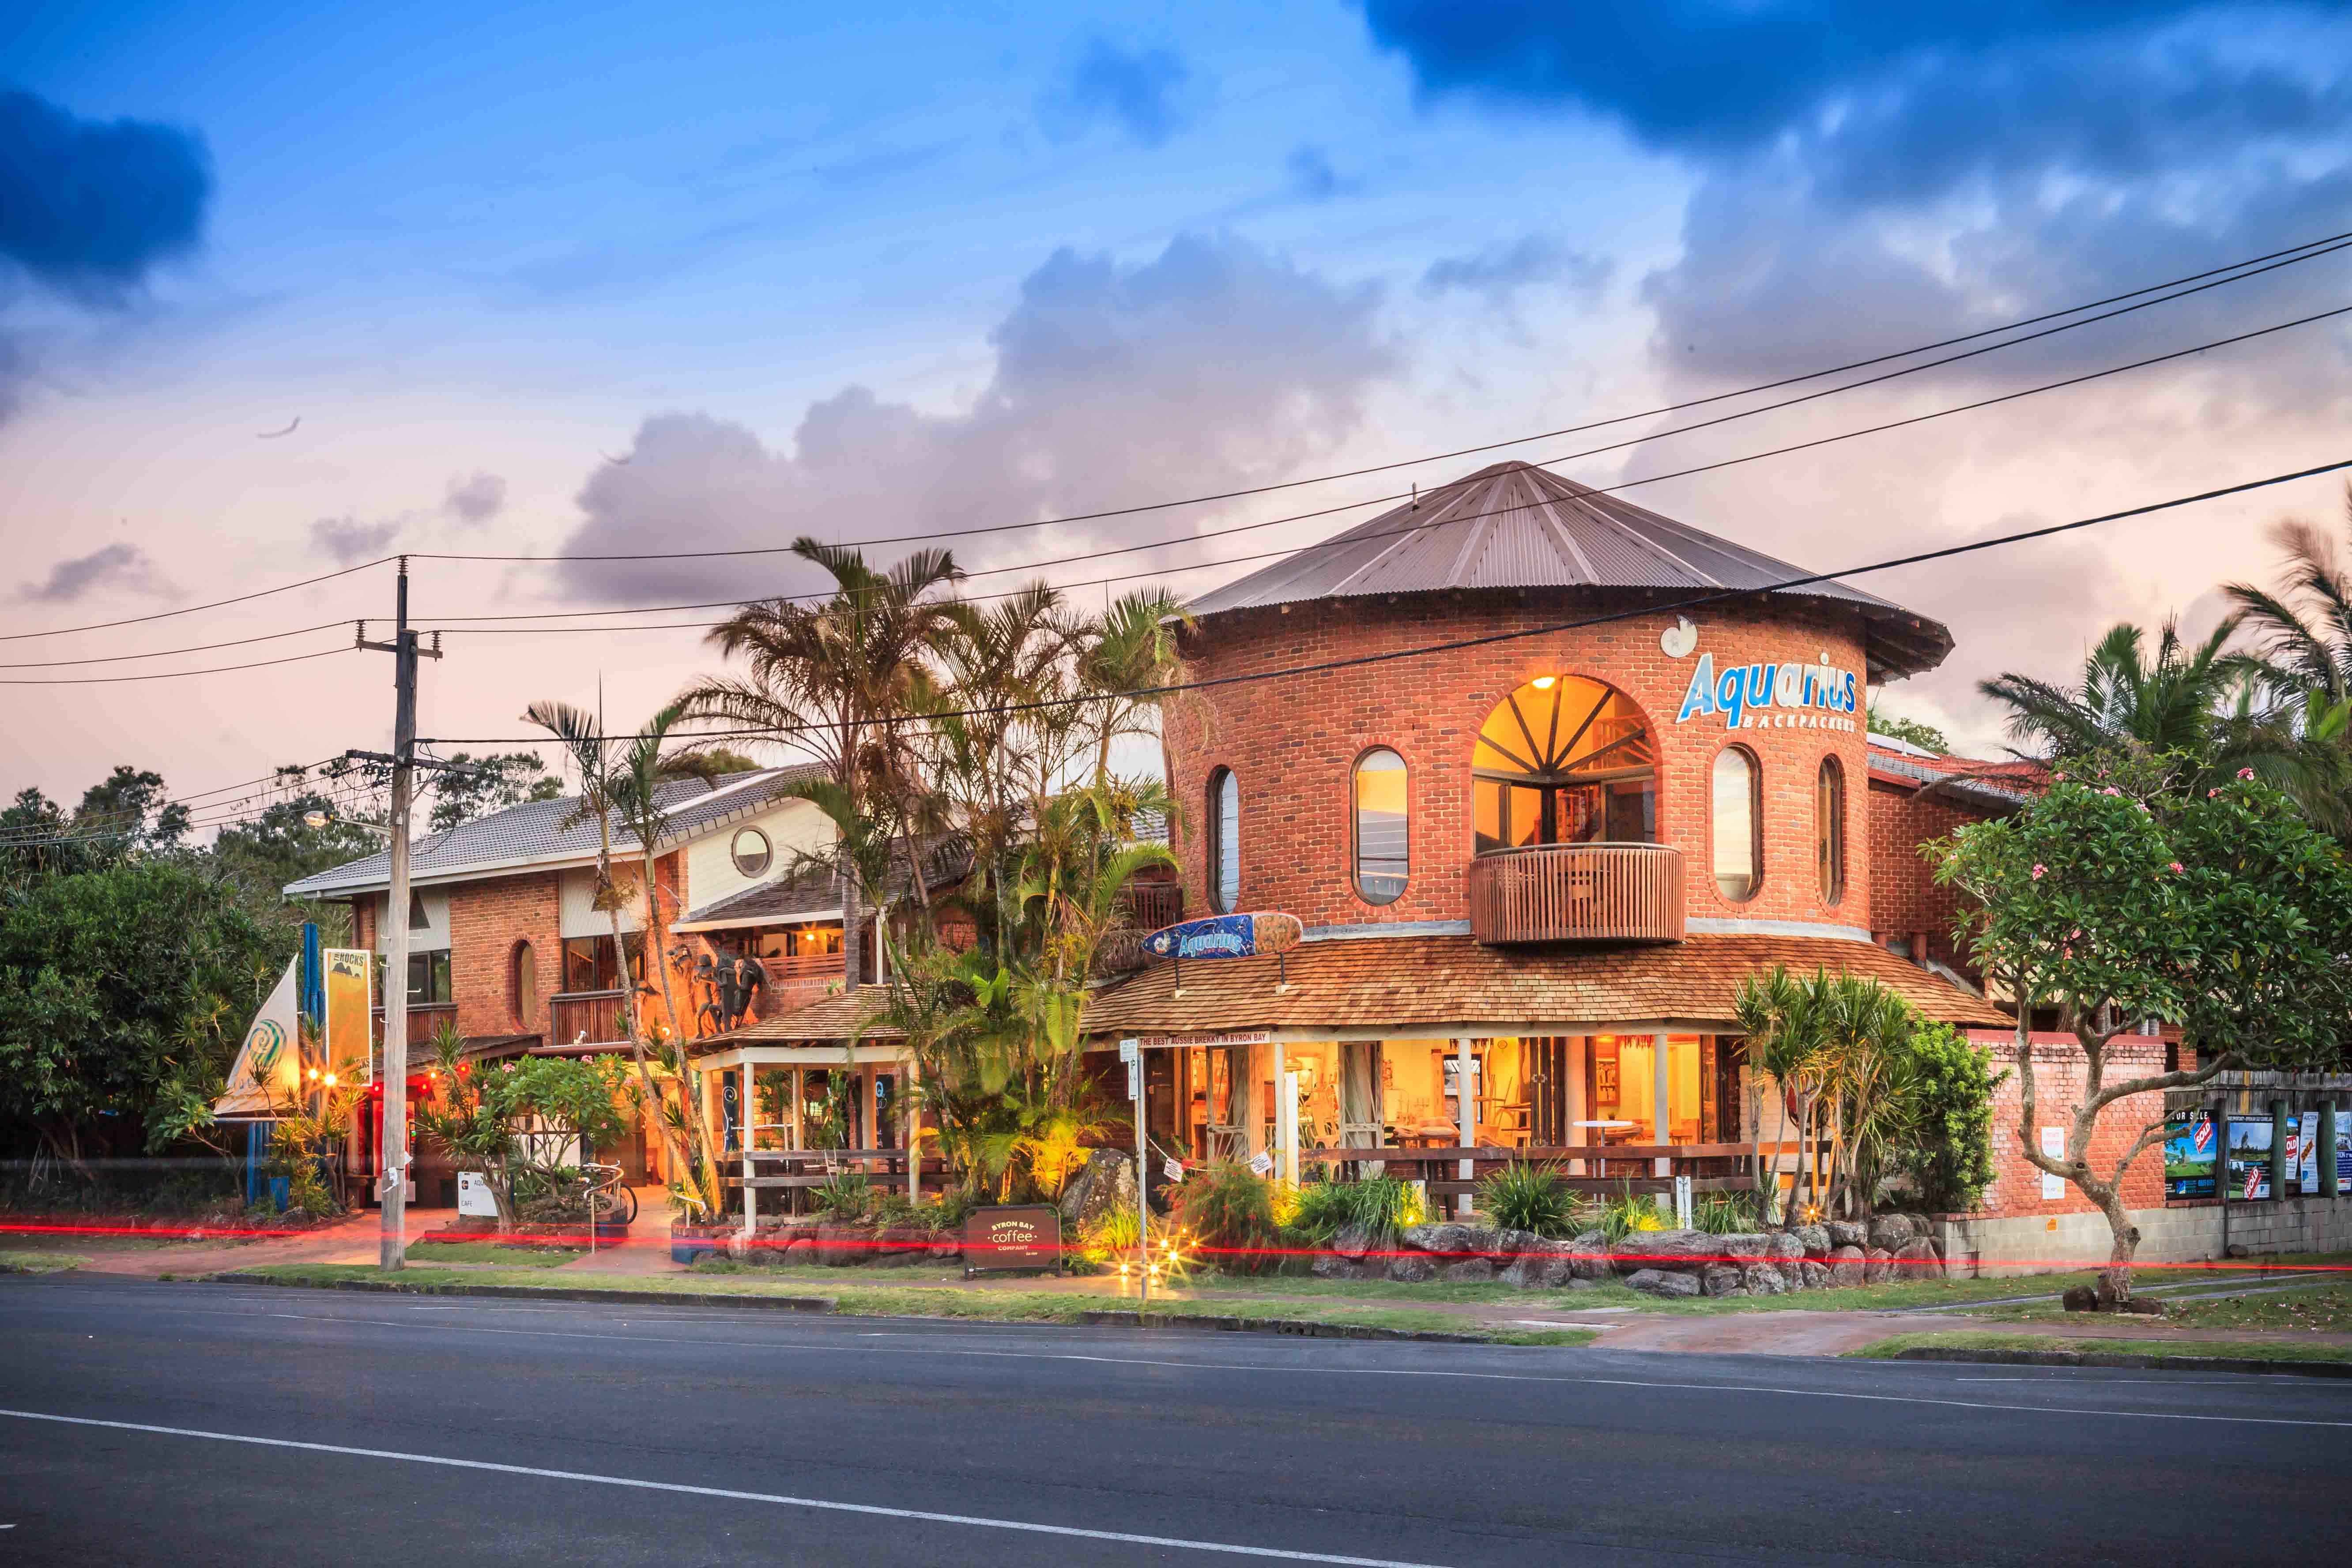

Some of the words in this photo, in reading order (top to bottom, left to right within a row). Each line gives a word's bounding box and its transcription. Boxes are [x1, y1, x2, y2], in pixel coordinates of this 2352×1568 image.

[1675, 652, 1855, 729] Aquarius
[1742, 714, 1854, 732] BACKPACKERS
[1178, 929, 1243, 957] Aquarius
[339, 953, 363, 967] ROCKS
[1171, 1036, 1193, 1044] AUSSIE
[1195, 1035, 1219, 1044] BREKKY
[2172, 1112, 2185, 1120] OR
[2190, 1111, 2208, 1120] SLE
[2196, 1123, 2211, 1146] SOLD
[2286, 1139, 2297, 1151] OLD
[2246, 1168, 2259, 1195] SOLD
[991, 1221, 1018, 1231] BYRON
[1019, 1221, 1035, 1230] BAY
[992, 1230, 1033, 1243] coffee
